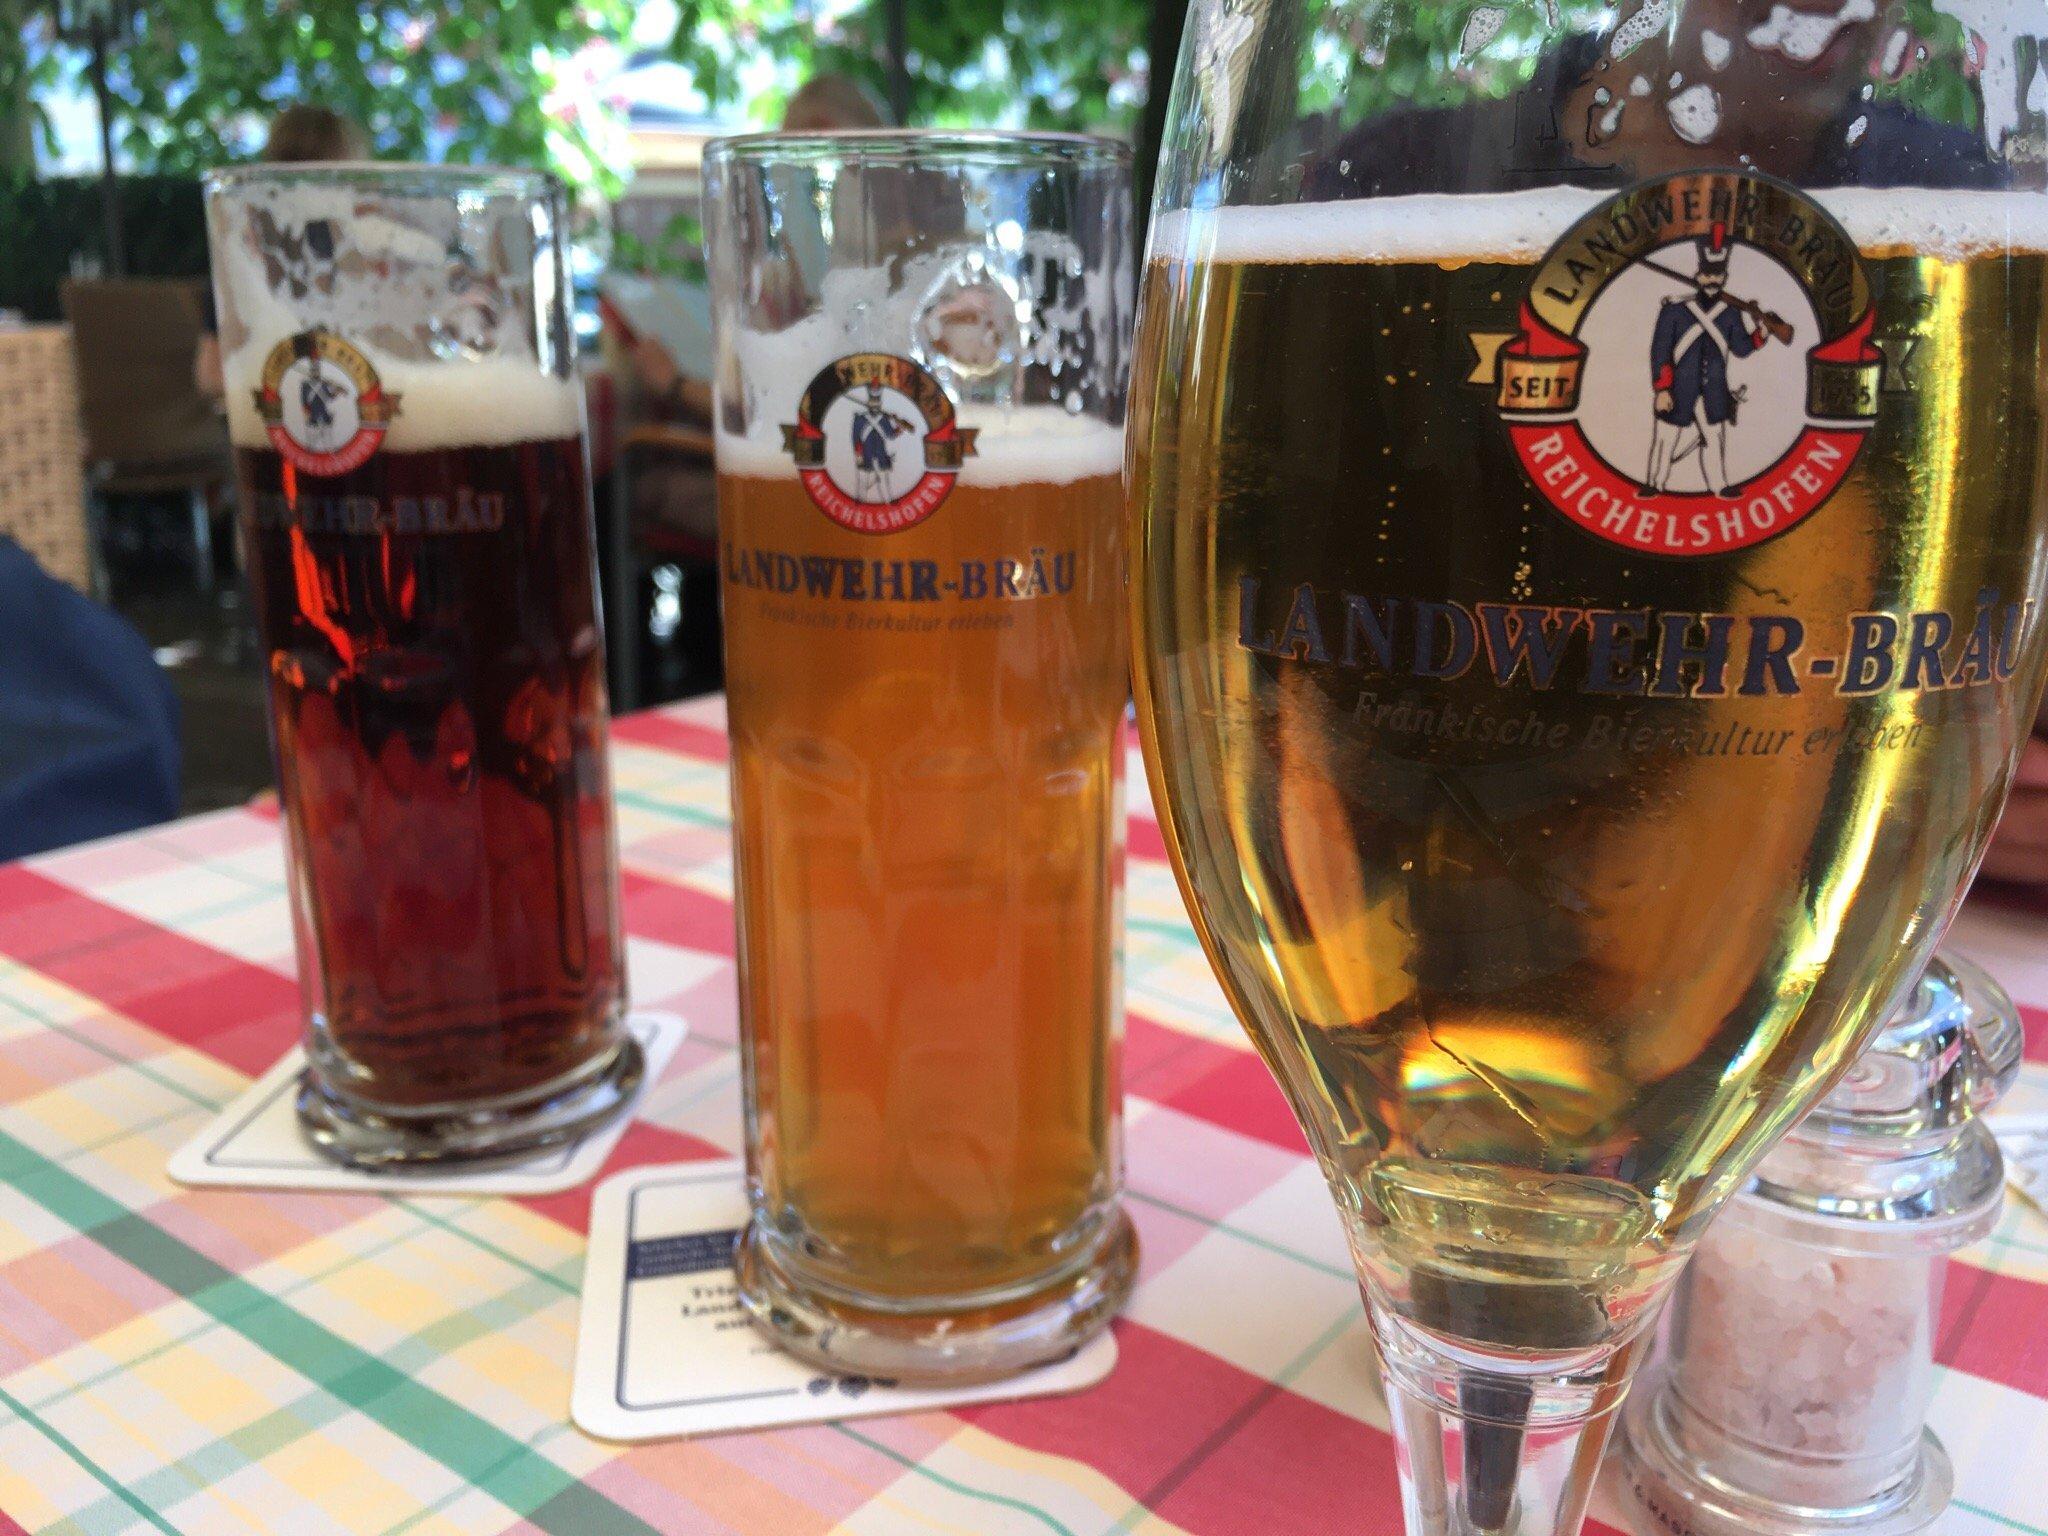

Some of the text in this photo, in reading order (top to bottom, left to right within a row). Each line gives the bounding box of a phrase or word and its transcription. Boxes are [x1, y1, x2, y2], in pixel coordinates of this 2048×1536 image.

[1509, 375, 1571, 399] SEIT
[808, 473, 946, 530] REICHELSHOFEN
[1528, 431, 1843, 548] REICHELSHOFEN
[726, 541, 1077, 602] LANDWEHR-BRÄU
[1236, 573, 2035, 698] LANDWEHR-BRÄU
[1352, 690, 1570, 750] Fränkische
[1582, 711, 1794, 757] Bierkultur
